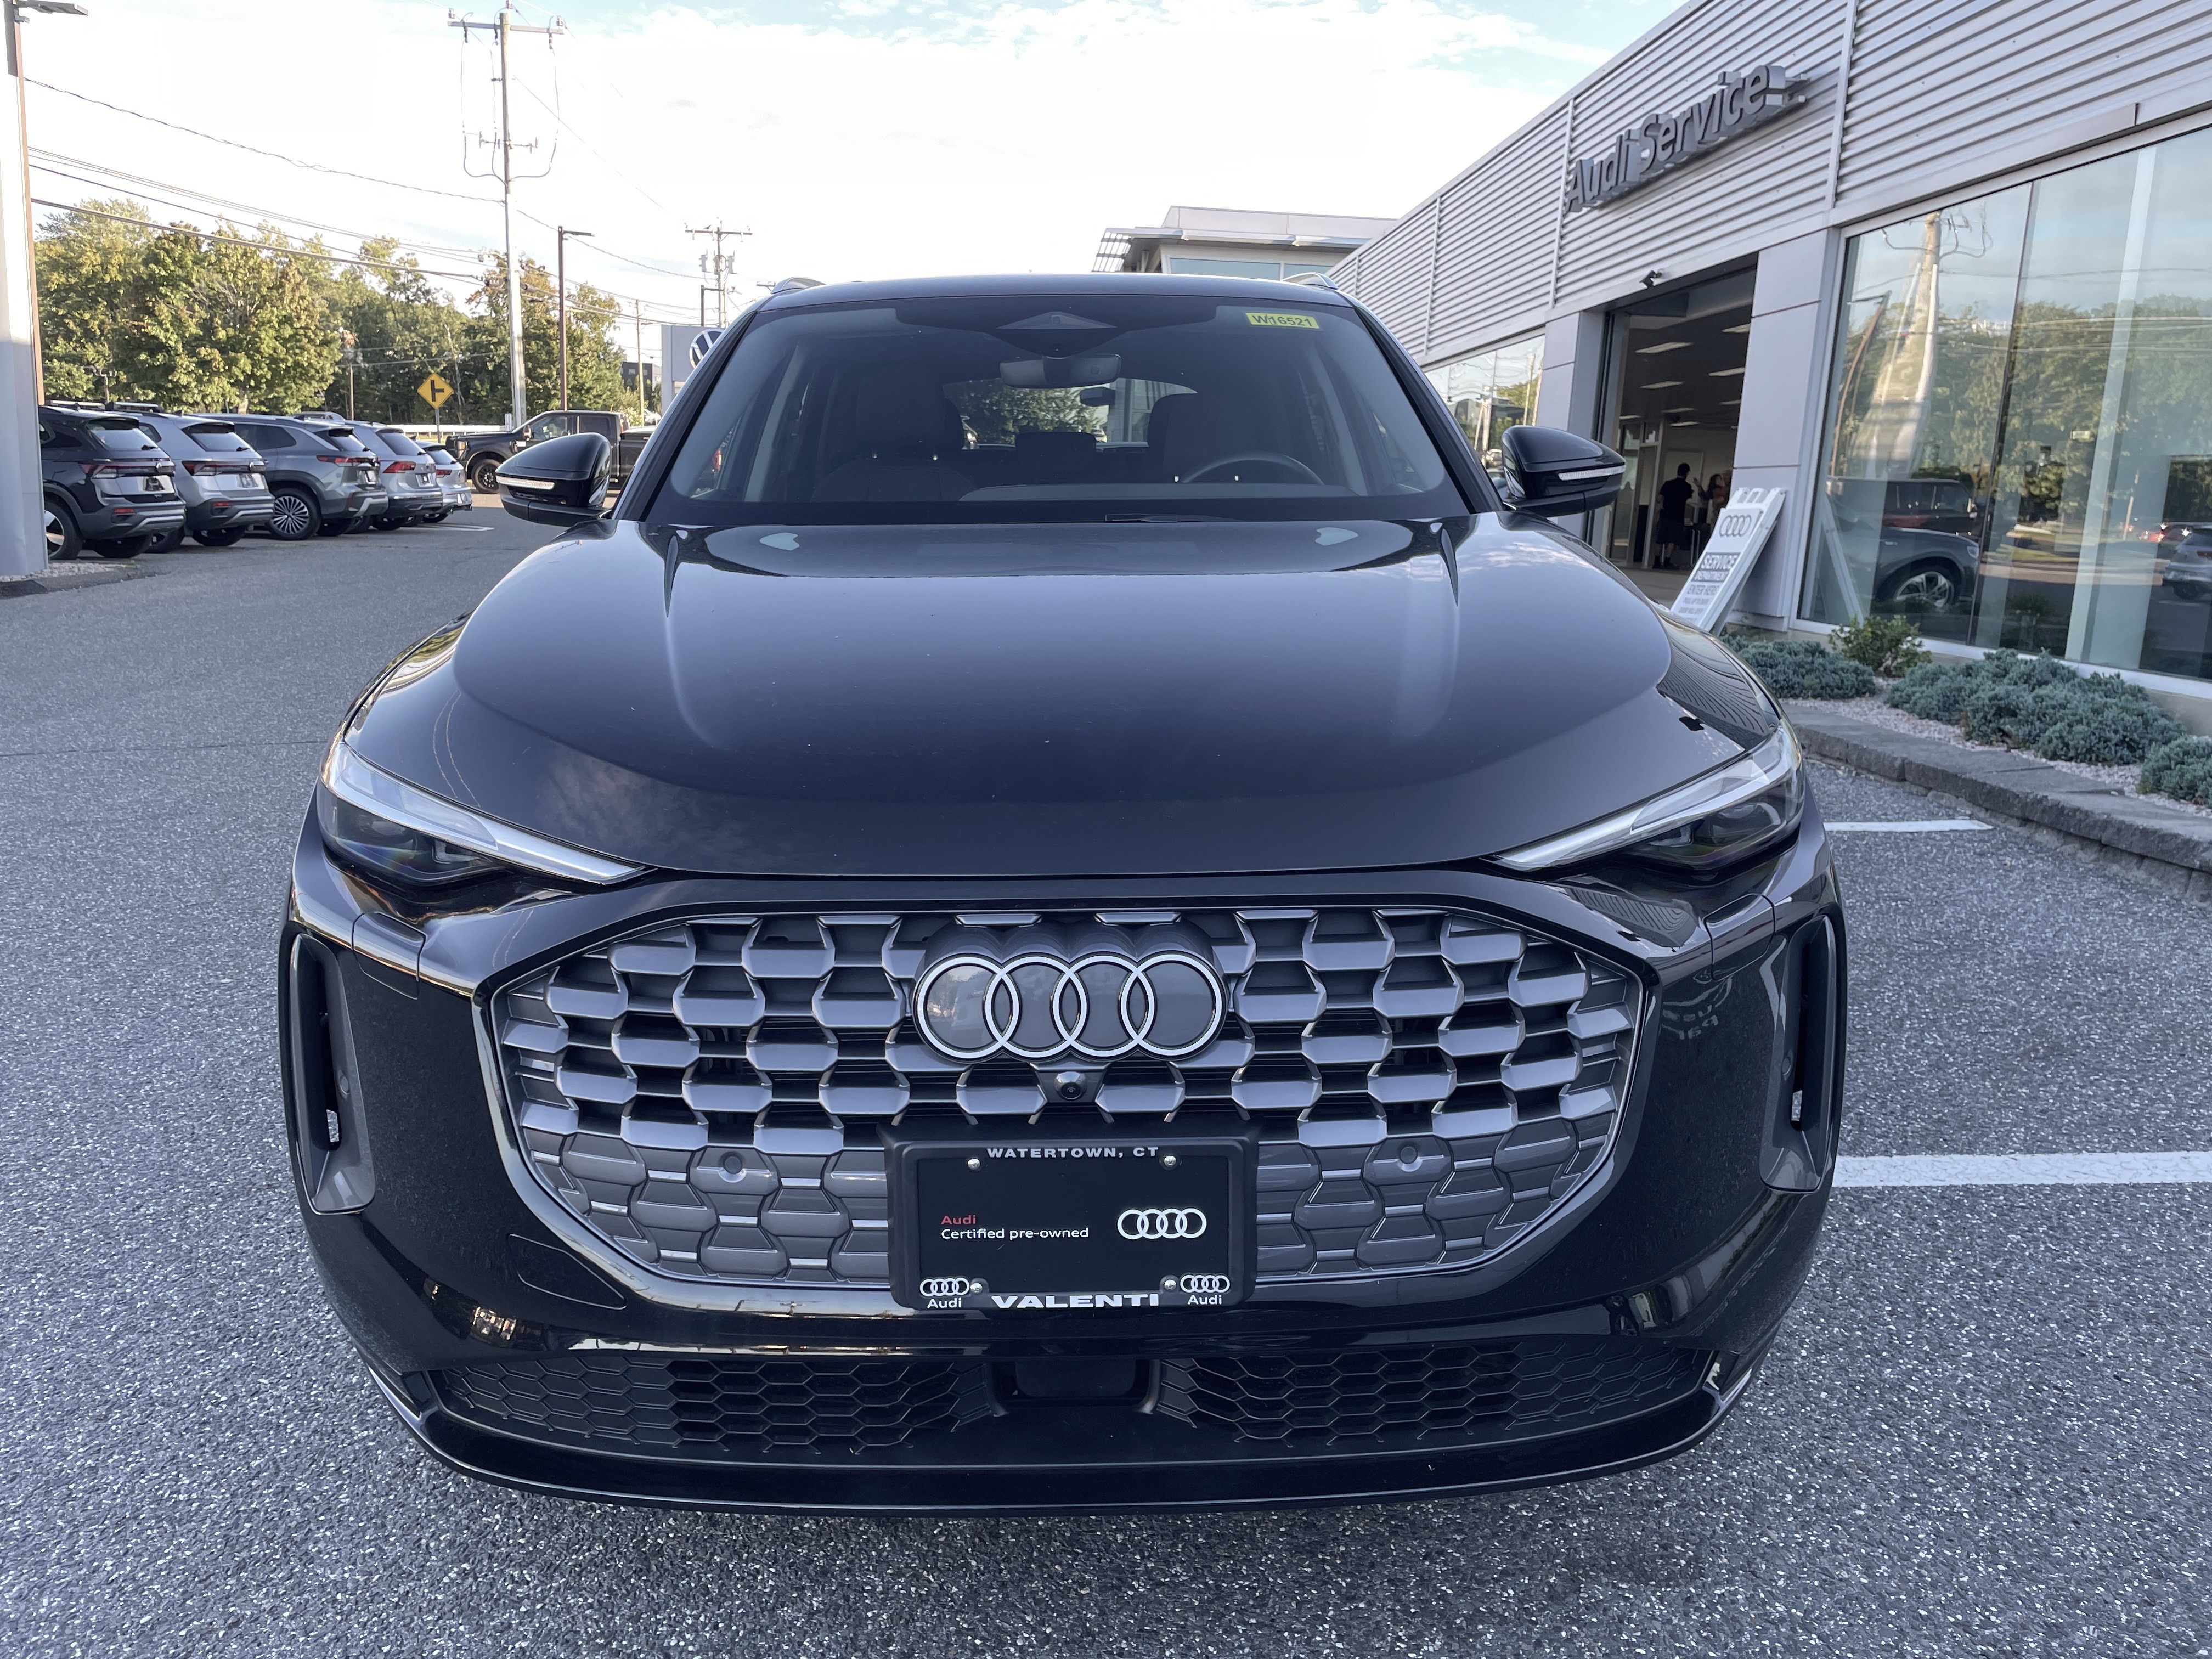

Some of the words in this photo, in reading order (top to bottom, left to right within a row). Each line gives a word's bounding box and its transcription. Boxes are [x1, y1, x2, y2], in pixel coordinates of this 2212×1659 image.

[1565, 129, 1639, 212] Audi
[1639, 65, 1780, 175] Service
[1252, 314, 1313, 327] W16521
[1701, 554, 1738, 569] SERVICE
[987, 1147, 1124, 1158] WATERTOWN,
[1132, 1147, 1159, 1157] CT
[940, 1215, 977, 1226] Audi
[940, 1228, 1005, 1240] Certified
[1009, 1227, 1089, 1240] pre-owned
[927, 1297, 962, 1309] Audi
[990, 1294, 1159, 1309] VALENTI
[1187, 1294, 1222, 1306] Audi
